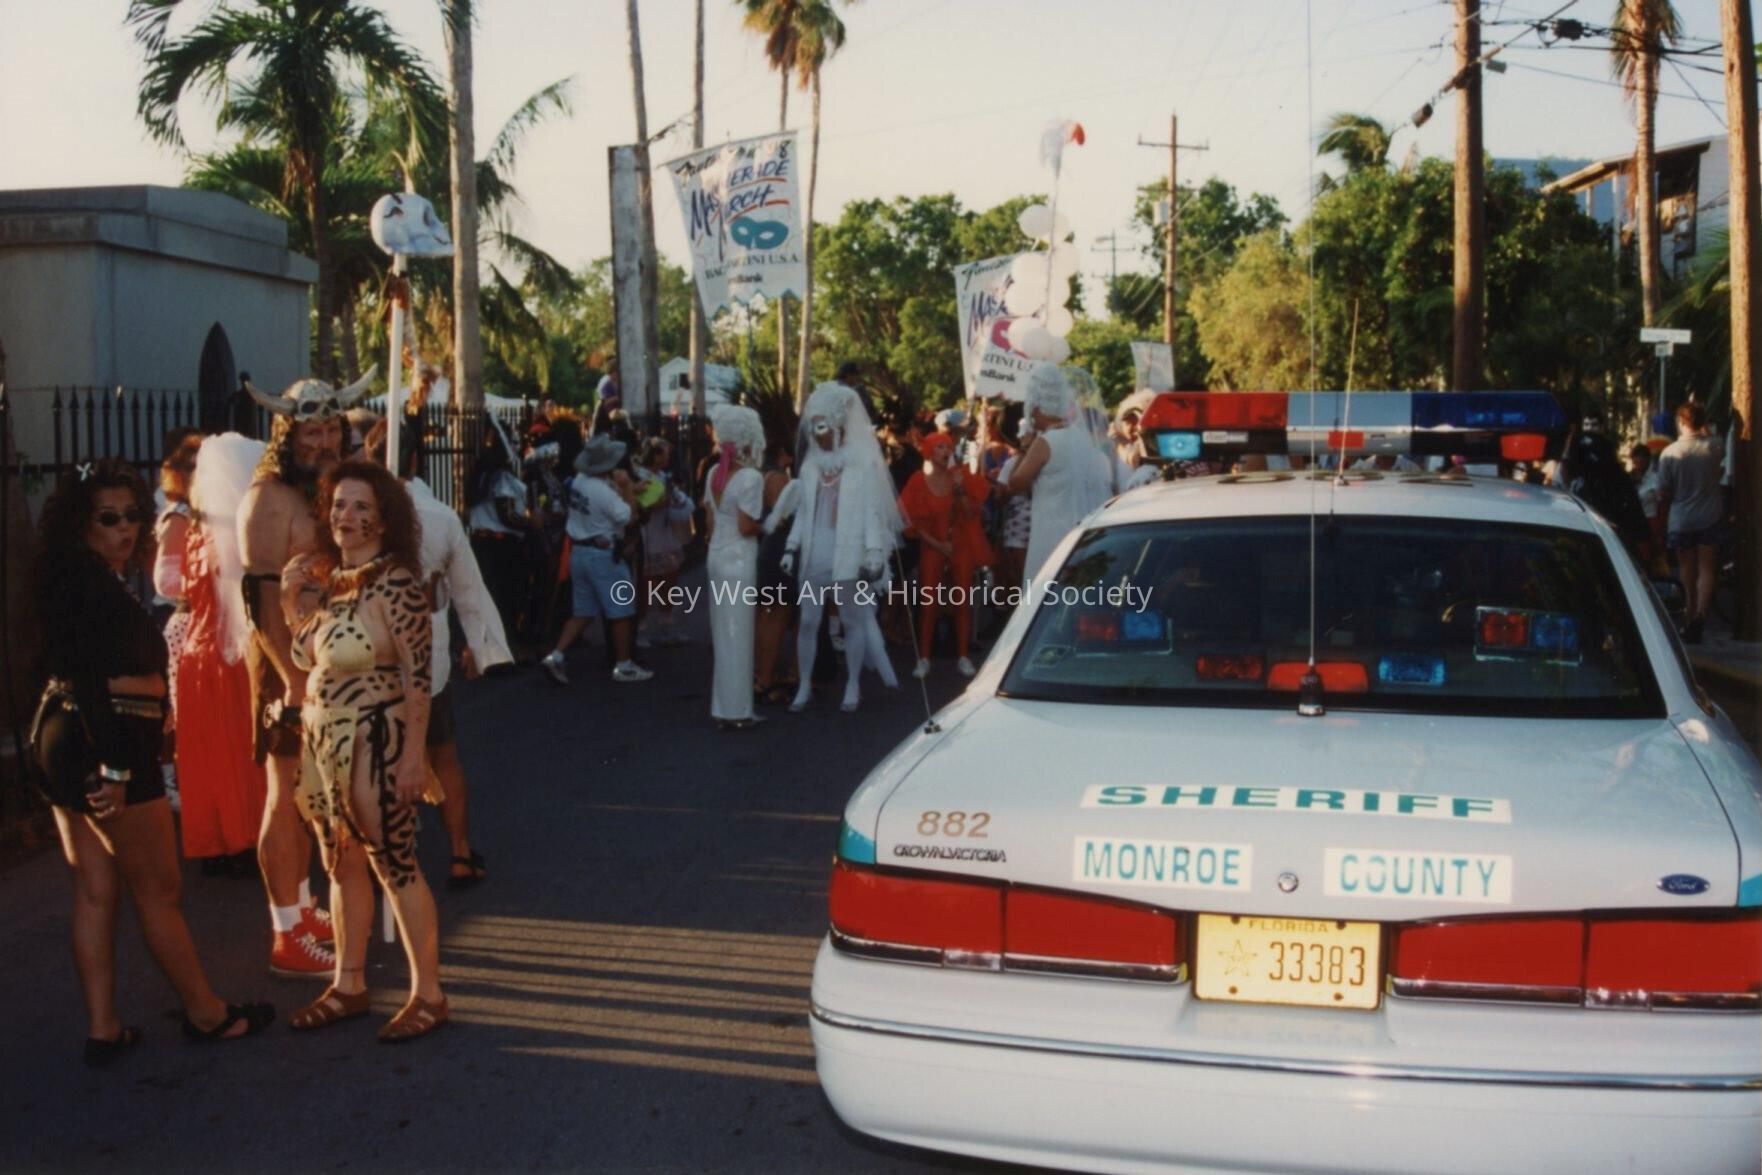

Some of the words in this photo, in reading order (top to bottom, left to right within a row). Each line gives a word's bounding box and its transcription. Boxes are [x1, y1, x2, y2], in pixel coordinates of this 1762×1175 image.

[1096, 786, 1494, 818] SHERIFF
[916, 810, 991, 838] 882
[1084, 841, 1241, 885] MONROE
[1339, 853, 1496, 897] COUNTY
[1248, 919, 1329, 933] FLORIDA
[1268, 941, 1365, 986] 33383
